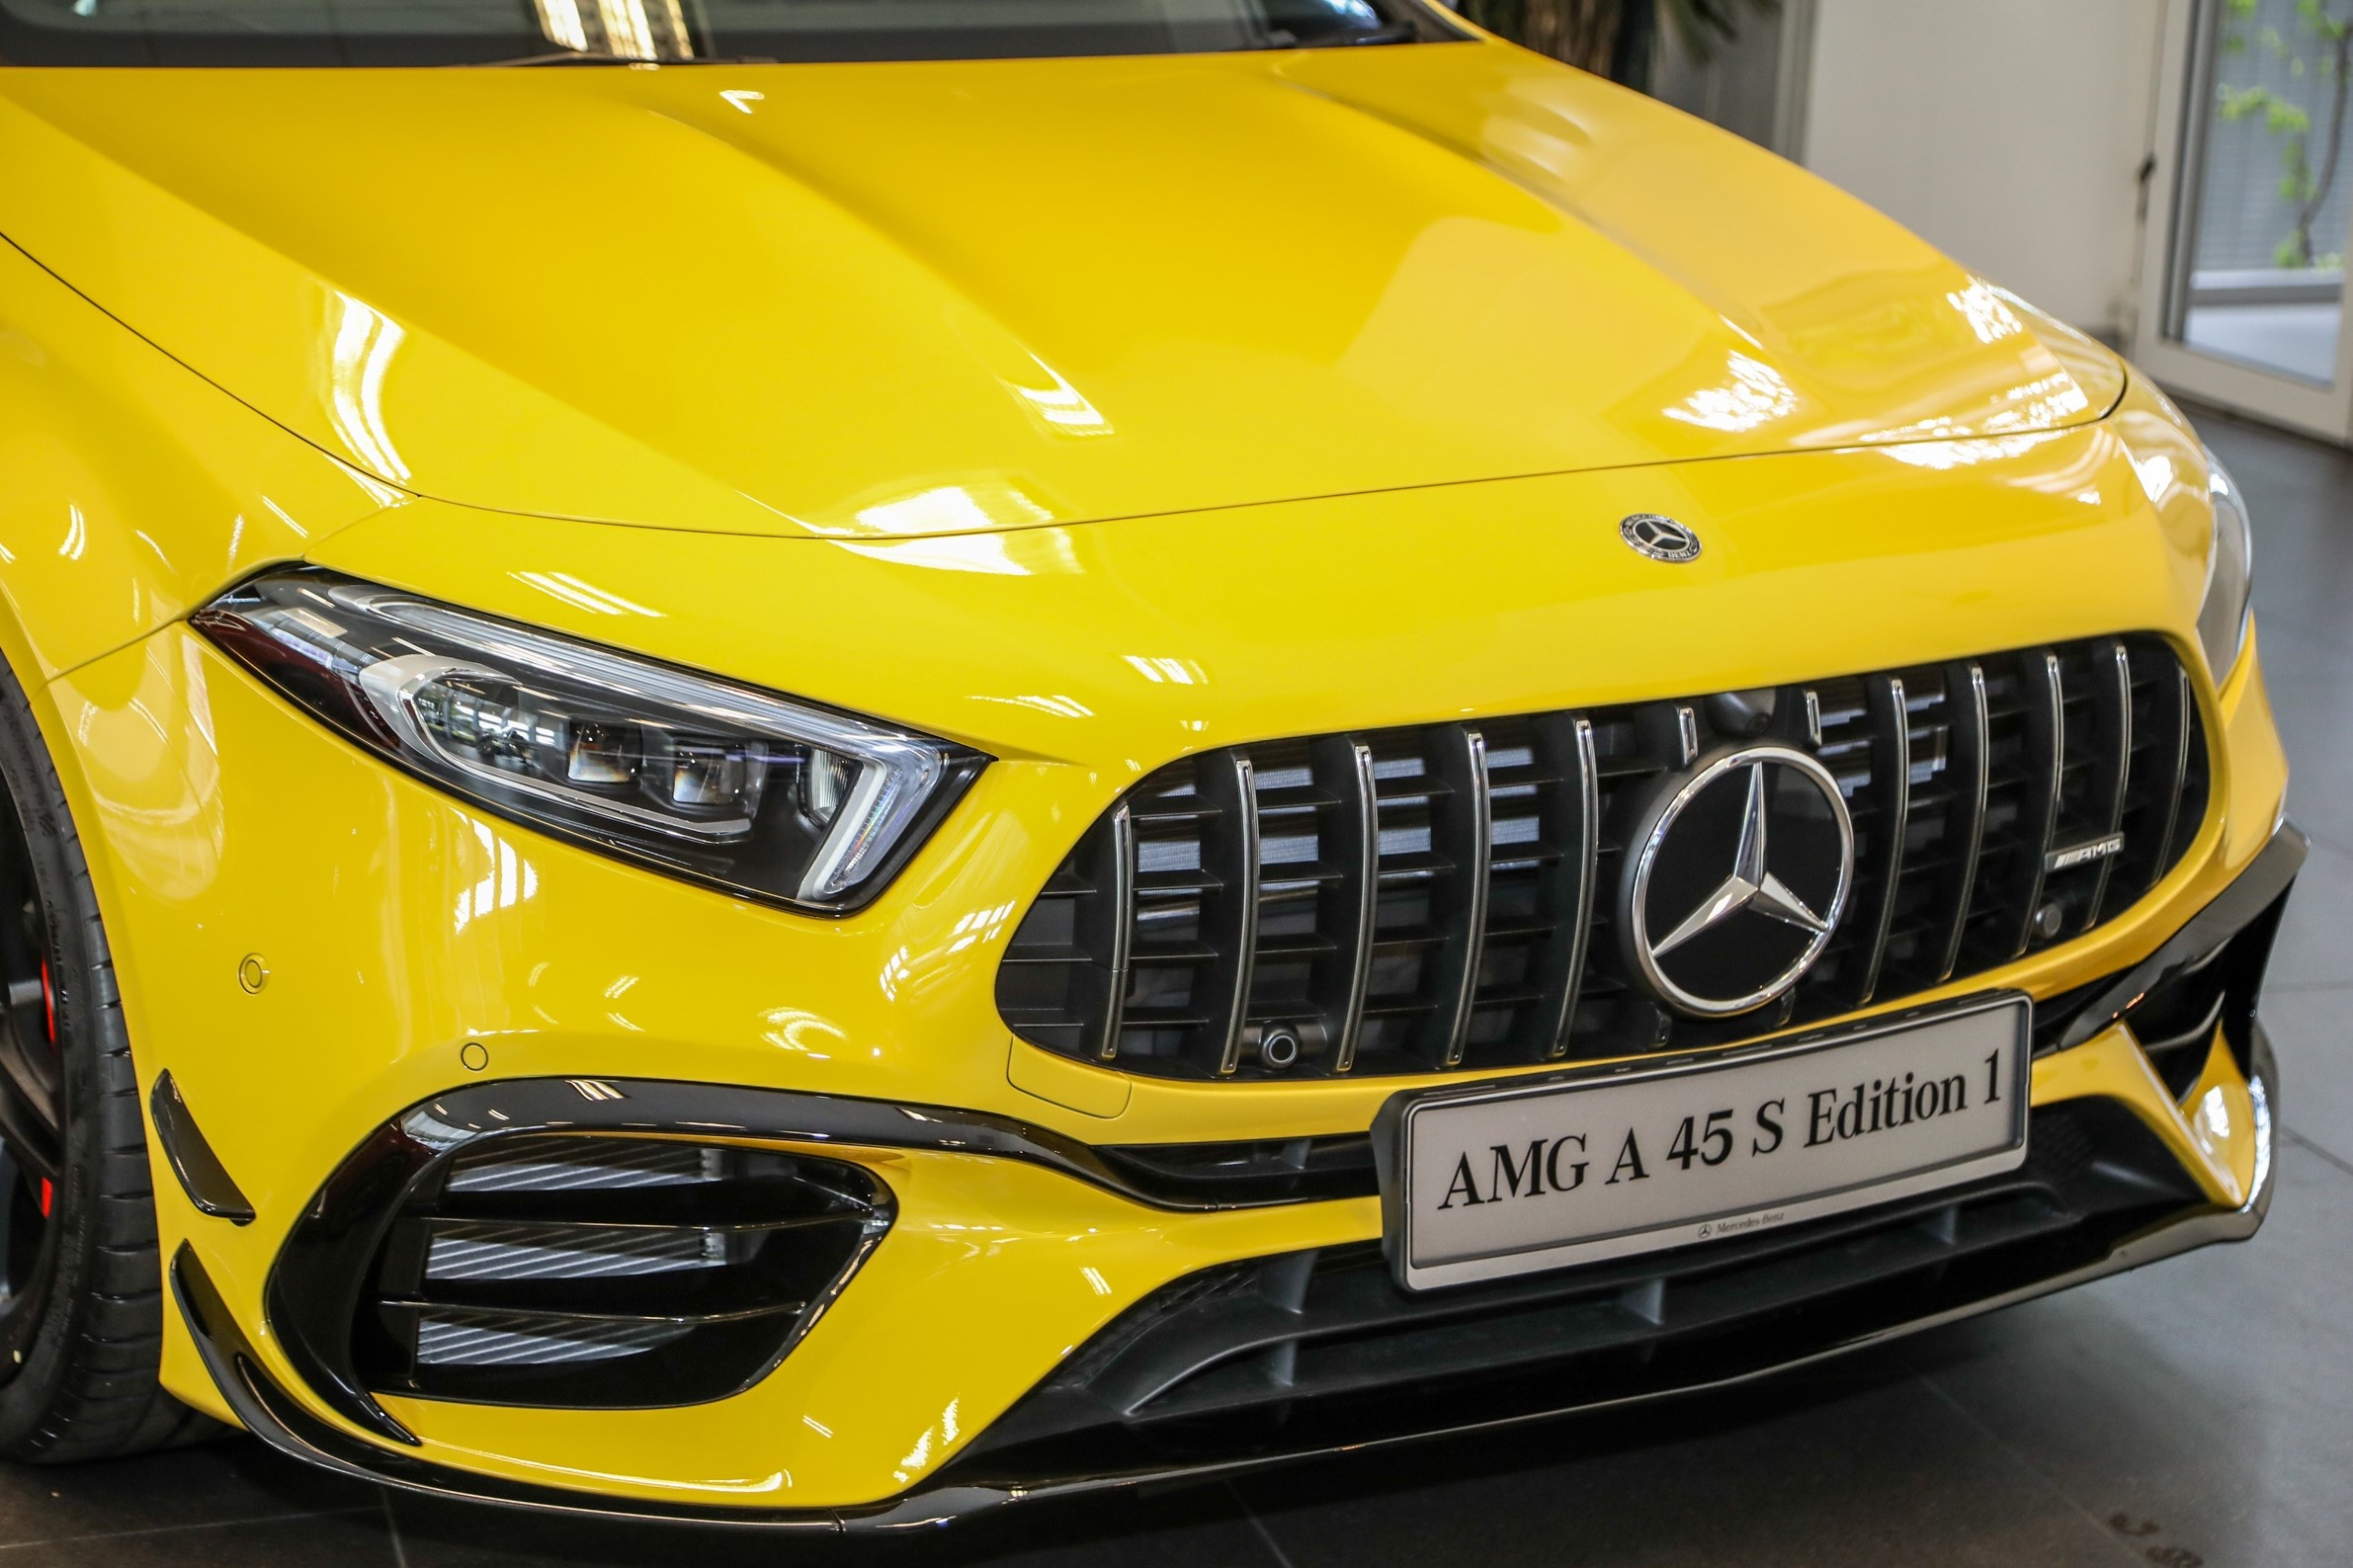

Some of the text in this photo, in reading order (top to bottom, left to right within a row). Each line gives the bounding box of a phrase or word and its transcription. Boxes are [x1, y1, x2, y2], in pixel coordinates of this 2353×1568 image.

[1437, 1048, 2002, 1210] AMG A 45 S Edition 1
